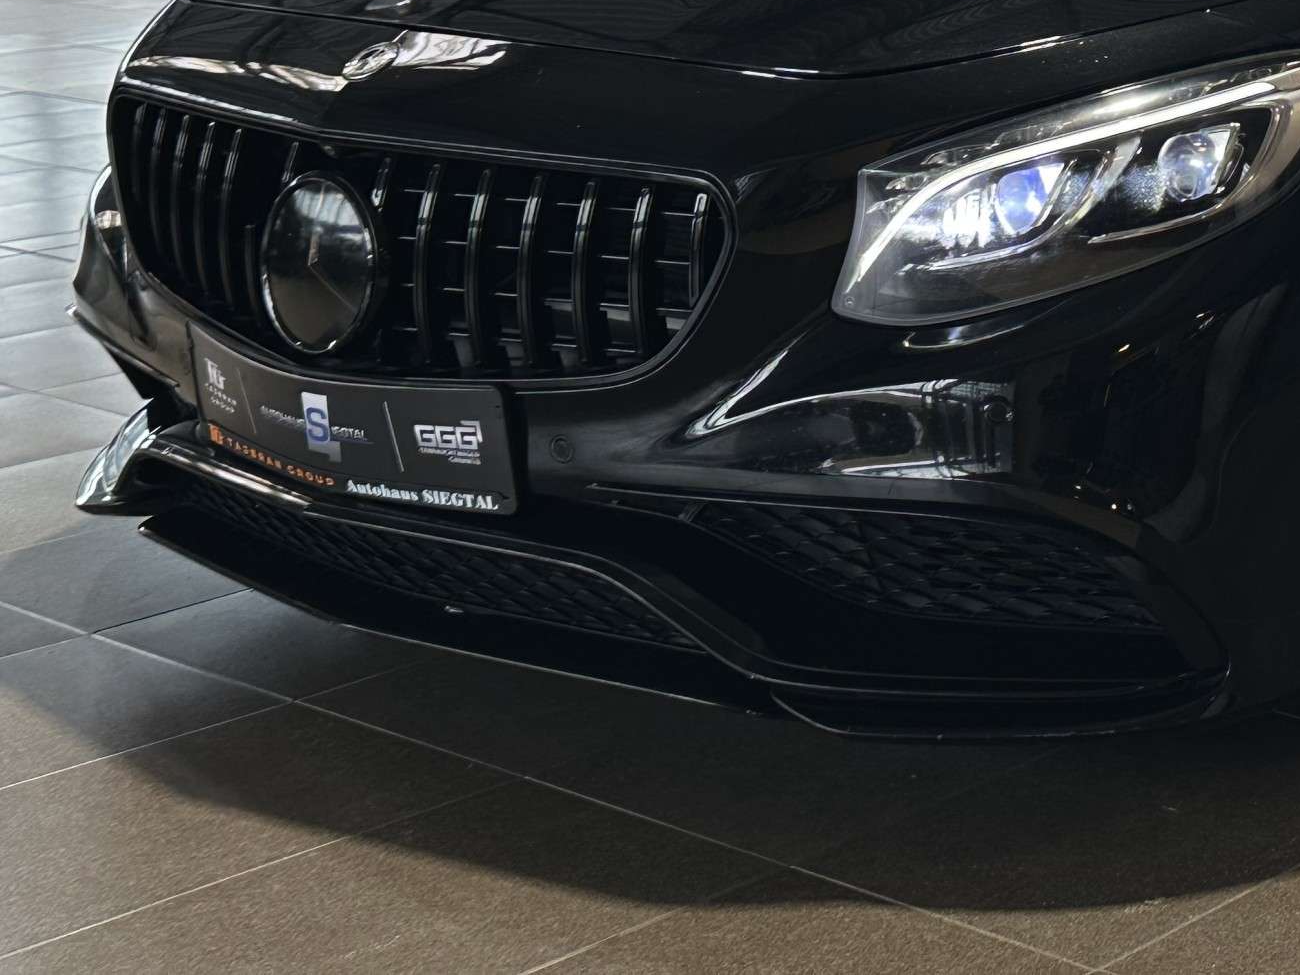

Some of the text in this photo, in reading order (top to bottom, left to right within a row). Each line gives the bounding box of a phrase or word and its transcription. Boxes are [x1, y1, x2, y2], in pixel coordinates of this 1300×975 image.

[413, 424, 478, 450] GGG
[347, 479, 499, 511] Autohaus SIEGTAL
